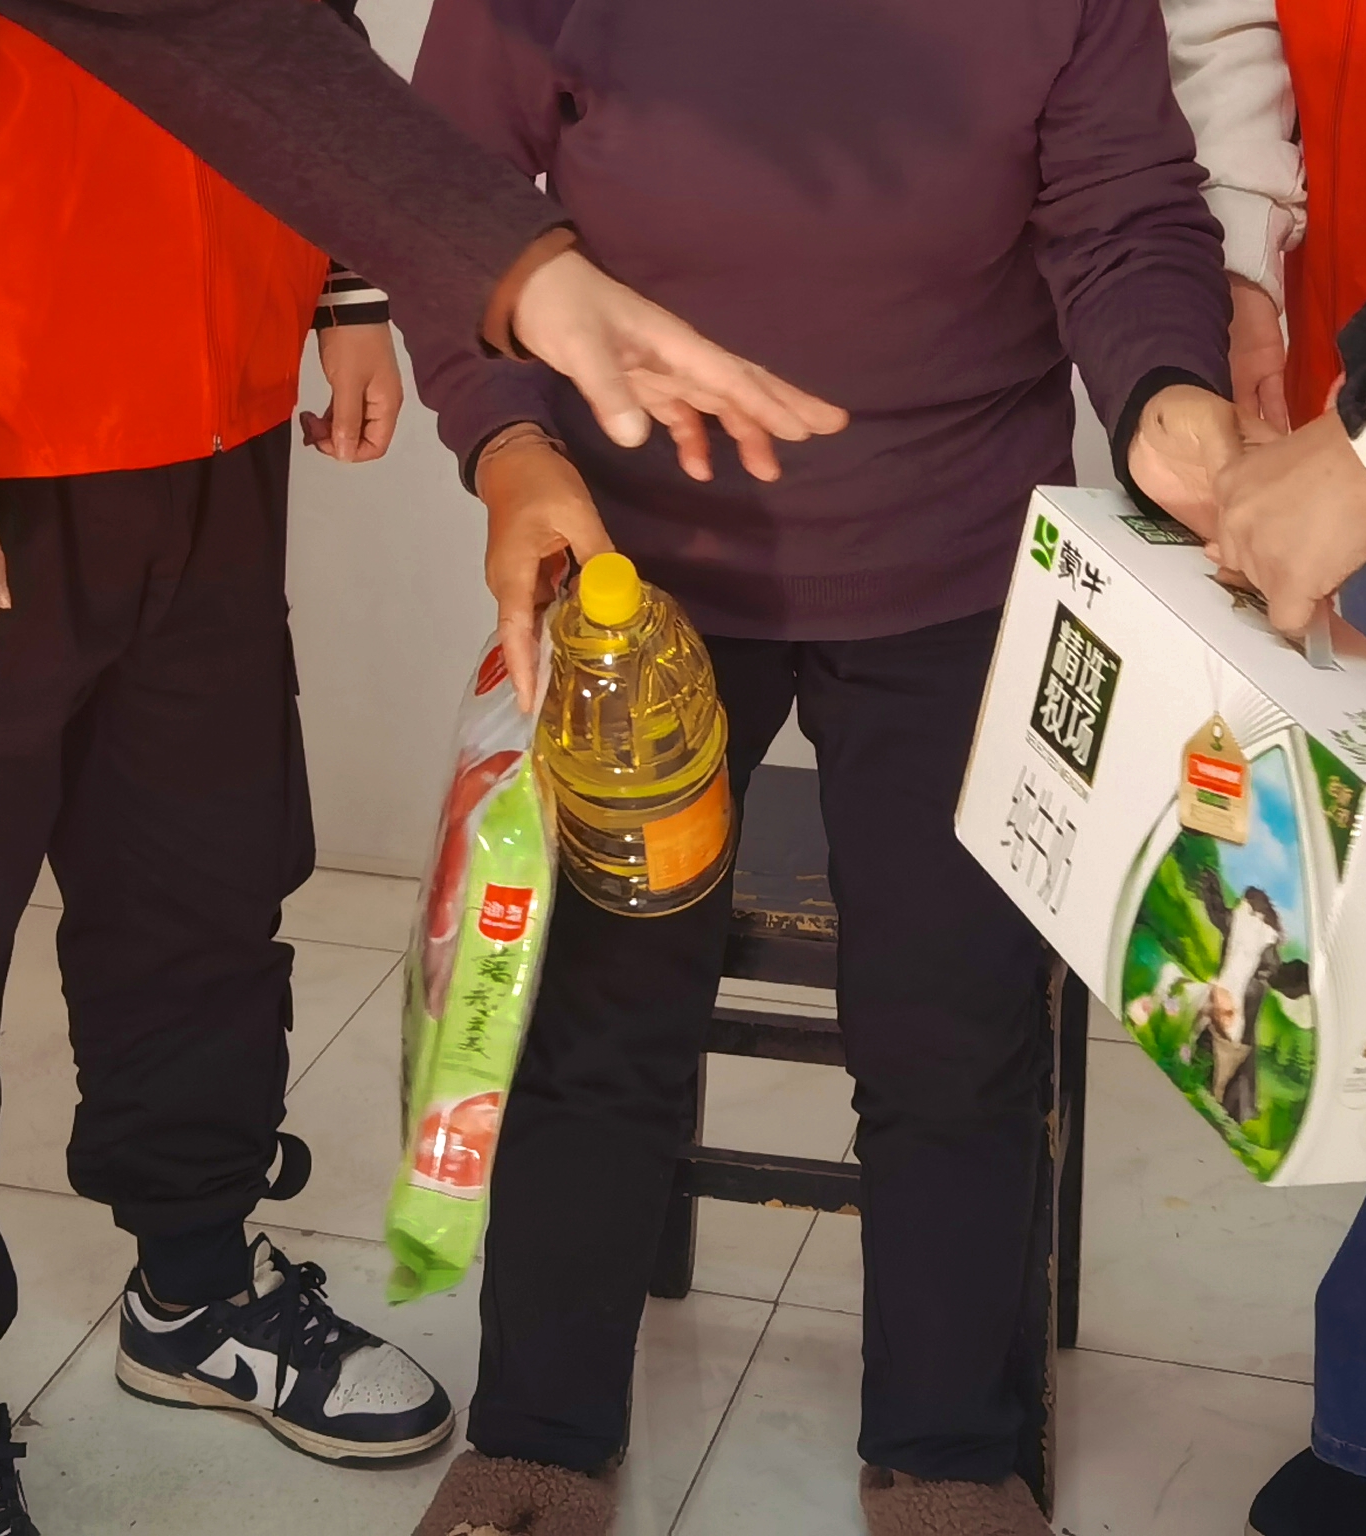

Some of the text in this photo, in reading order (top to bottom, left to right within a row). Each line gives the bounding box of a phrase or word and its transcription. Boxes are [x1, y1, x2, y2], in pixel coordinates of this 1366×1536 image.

[1057, 539, 1107, 610] 蒙牛
[1050, 619, 1117, 714] 精选
[1038, 671, 1097, 766] 牧场
